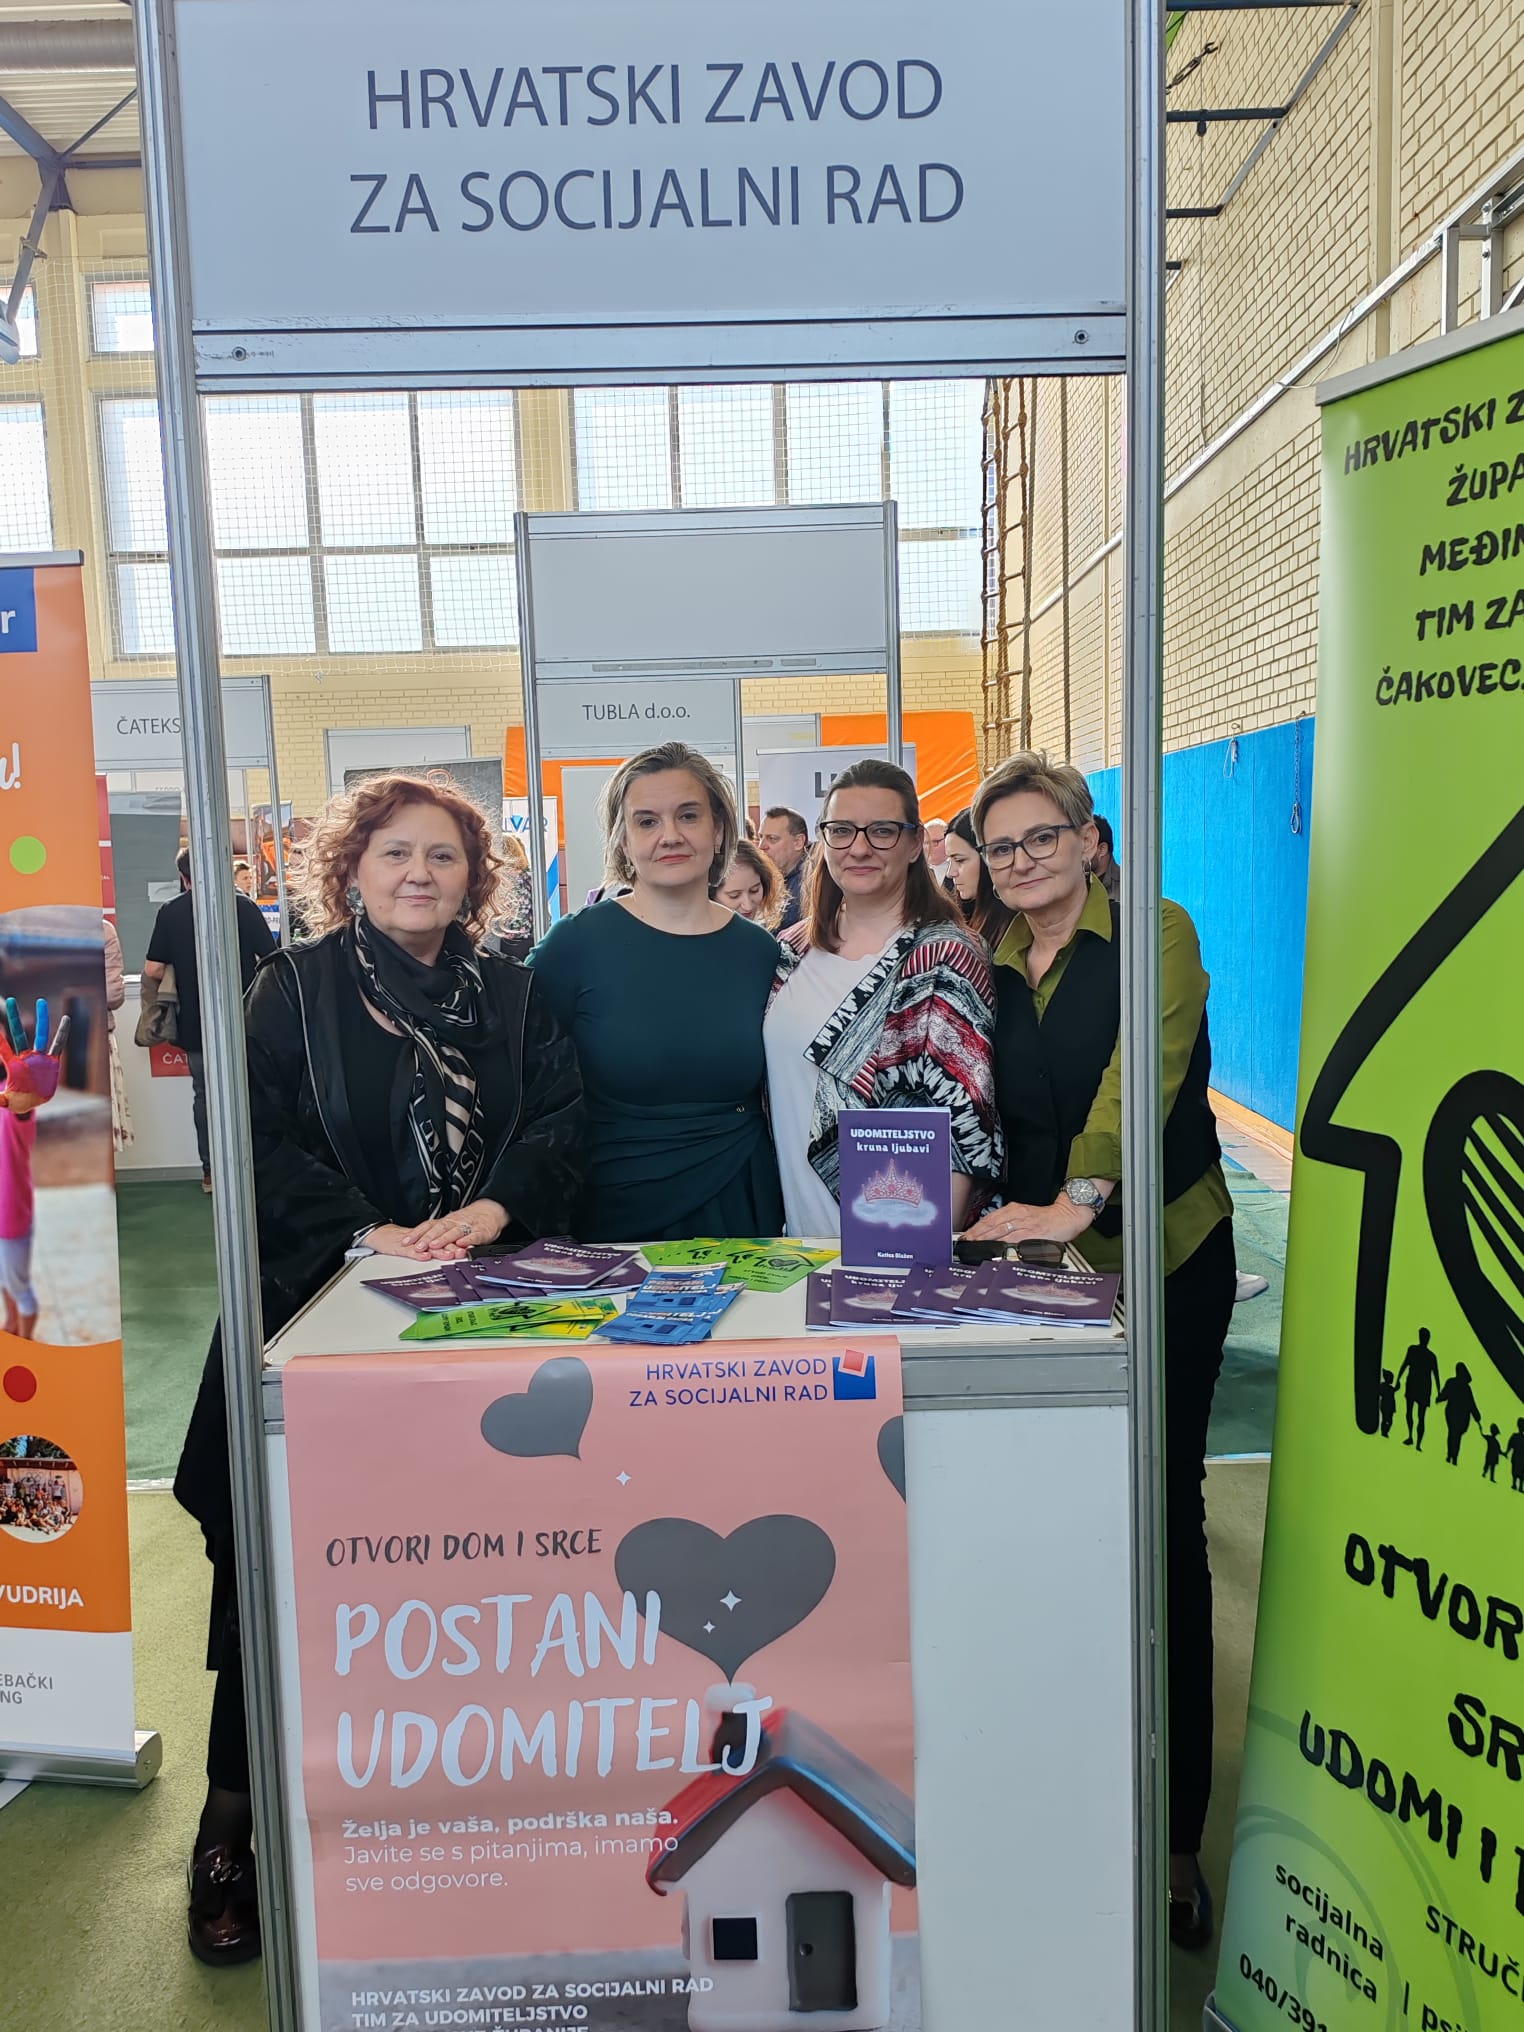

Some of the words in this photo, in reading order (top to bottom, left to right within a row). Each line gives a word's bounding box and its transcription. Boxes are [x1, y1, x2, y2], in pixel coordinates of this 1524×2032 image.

[366, 64, 682, 130] HRVATSKI
[704, 59, 943, 124] ZAVOD
[349, 172, 440, 233] ZA
[460, 166, 800, 233] SOCIJALNI
[825, 162, 965, 225] RAD
[1344, 398, 1497, 475] HRVATSKI
[1416, 600, 1474, 641] TIM
[116, 715, 181, 735] ČATEKS
[582, 703, 640, 720] TUBLA
[644, 703, 691, 719] d.o.o.
[850, 1128, 936, 1140] UDOMITELJSTVO
[856, 1142, 889, 1152] kruna
[891, 1143, 930, 1154] ljubavi
[646, 1361, 746, 1381] HRVATSKI
[753, 1358, 828, 1378] ZAVOD
[629, 1389, 658, 1408] ZA
[665, 1385, 777, 1406] SOCIJALNI
[785, 1383, 829, 1402] RAD
[326, 1533, 430, 1568] OTVORI
[443, 1533, 504, 1561] DOM
[516, 1530, 524, 1558] I
[535, 1528, 603, 1558] SRCE
[333, 1590, 663, 1681] POSTANI
[336, 1695, 774, 1789] UDOMITELJ
[1299, 1710, 1463, 1860] UDOMI
[342, 1818, 402, 1840] Želja
[408, 1818, 431, 1839] je
[438, 1815, 500, 1835] vaša,
[508, 1810, 608, 1835] podrška
[615, 1807, 679, 1827] naša.
[344, 1844, 413, 1864] Javite
[419, 1846, 444, 1862] se
[451, 1847, 463, 1860] s
[470, 1838, 588, 1864] pitanjima,
[595, 1835, 679, 1854] imamo
[345, 1875, 384, 1892] sve
[390, 1870, 508, 1894] odgovore.
[1275, 1863, 1384, 1962] socijalna
[1286, 1913, 1377, 2004] radnica
[351, 1988, 451, 2007] HRVATSKI
[457, 1985, 527, 2002] ZAVOD
[532, 1983, 559, 2000] ZA
[565, 1980, 666, 1999] SOCIJALNI
[672, 1977, 714, 1993] RAD
[351, 2012, 387, 2028] TIM
[392, 2010, 419, 2026] ZA
[425, 2004, 588, 2025] UDOMITELJSTVO
